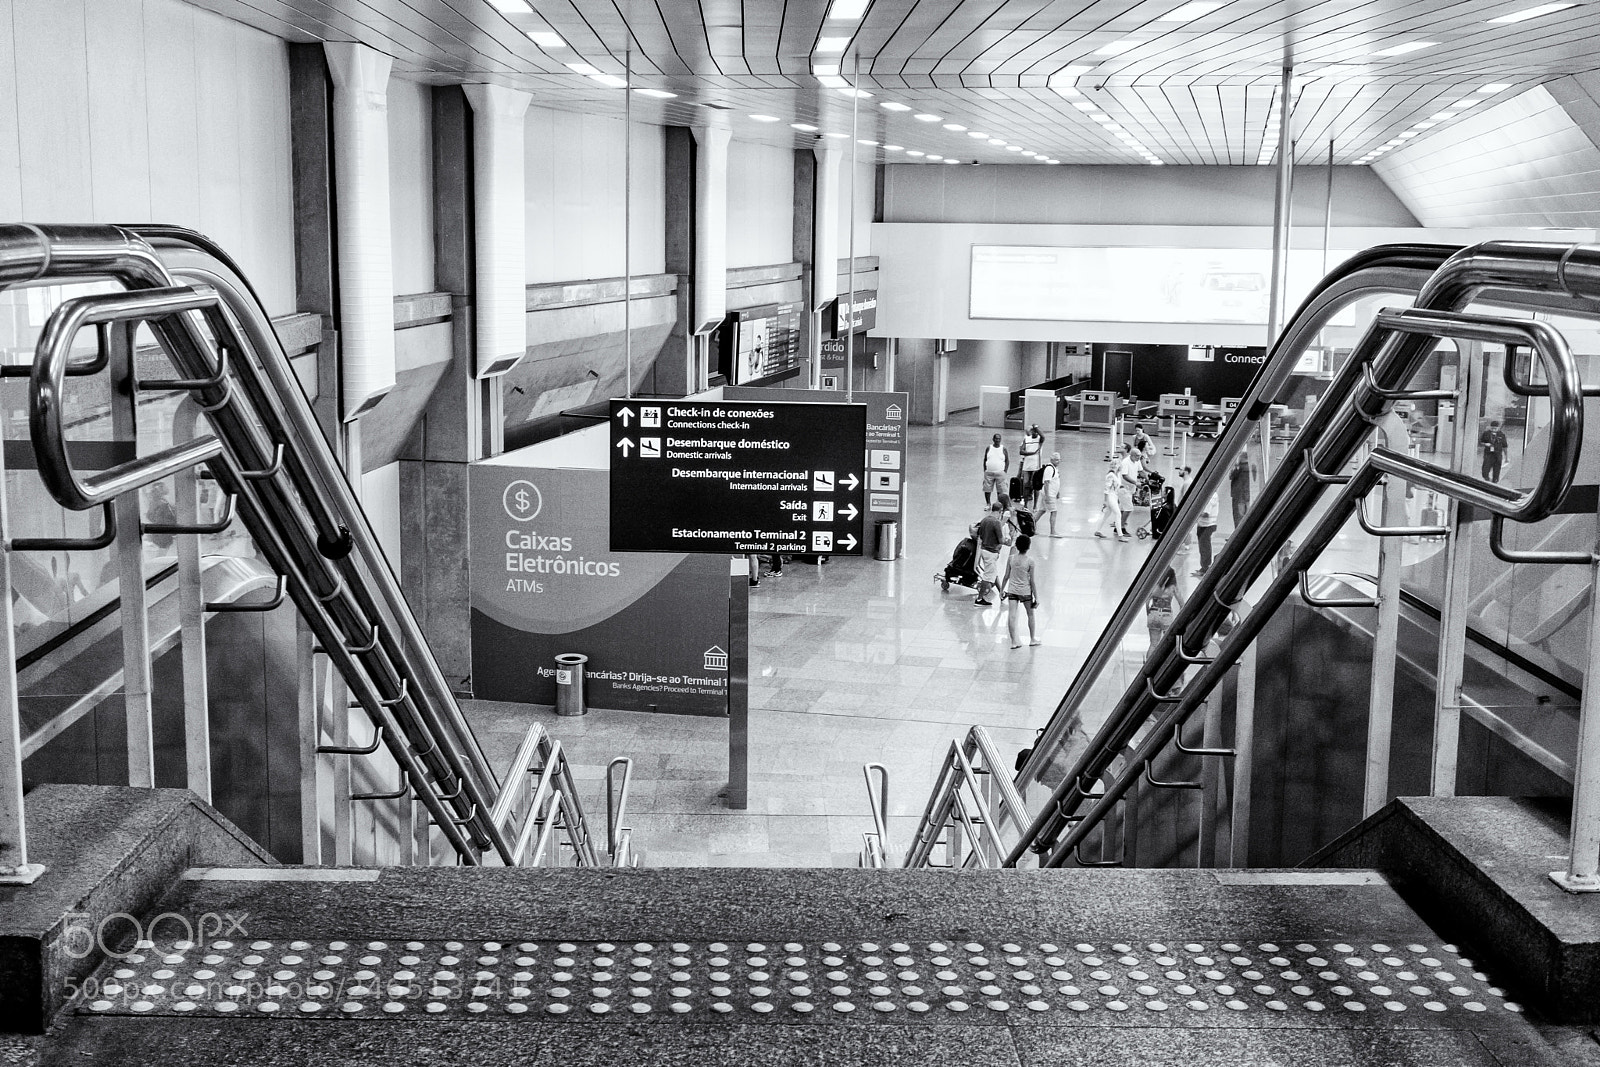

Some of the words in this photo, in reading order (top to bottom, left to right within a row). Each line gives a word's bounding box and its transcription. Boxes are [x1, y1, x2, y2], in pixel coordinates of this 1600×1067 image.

[666, 406, 711, 418] Check-in
[712, 407, 726, 418] de
[727, 408, 775, 419] conexões
[667, 419, 717, 429] Connections
[716, 420, 750, 430] check-in
[666, 437, 737, 450] Desembarque
[737, 438, 790, 450] doméstico
[666, 450, 704, 459] Domestic
[704, 451, 732, 460] arrivals
[671, 467, 742, 481] Desembarque
[742, 469, 809, 480] internacional
[729, 481, 779, 491] International
[779, 483, 808, 492] arrivals
[779, 500, 808, 510] Saída
[792, 513, 807, 522] Exit
[671, 527, 753, 539] Estacionamento
[753, 529, 798, 540] Terminal
[799, 530, 807, 540] 2
[505, 529, 573, 552] Caixas
[734, 541, 768, 551] Terminal
[769, 542, 775, 551] 2
[776, 542, 807, 553] parking
[506, 552, 621, 577] Eletrônicos
[505, 578, 544, 594] ATMs
[585, 670, 627, 682] ancárias?
[628, 672, 668, 684] Dirija-se
[668, 676, 681, 684] ao
[682, 675, 722, 687] Terminal
[722, 678, 728, 687] 1
[612, 681, 632, 690] Banks
[697, 688, 721, 696] Terminal
